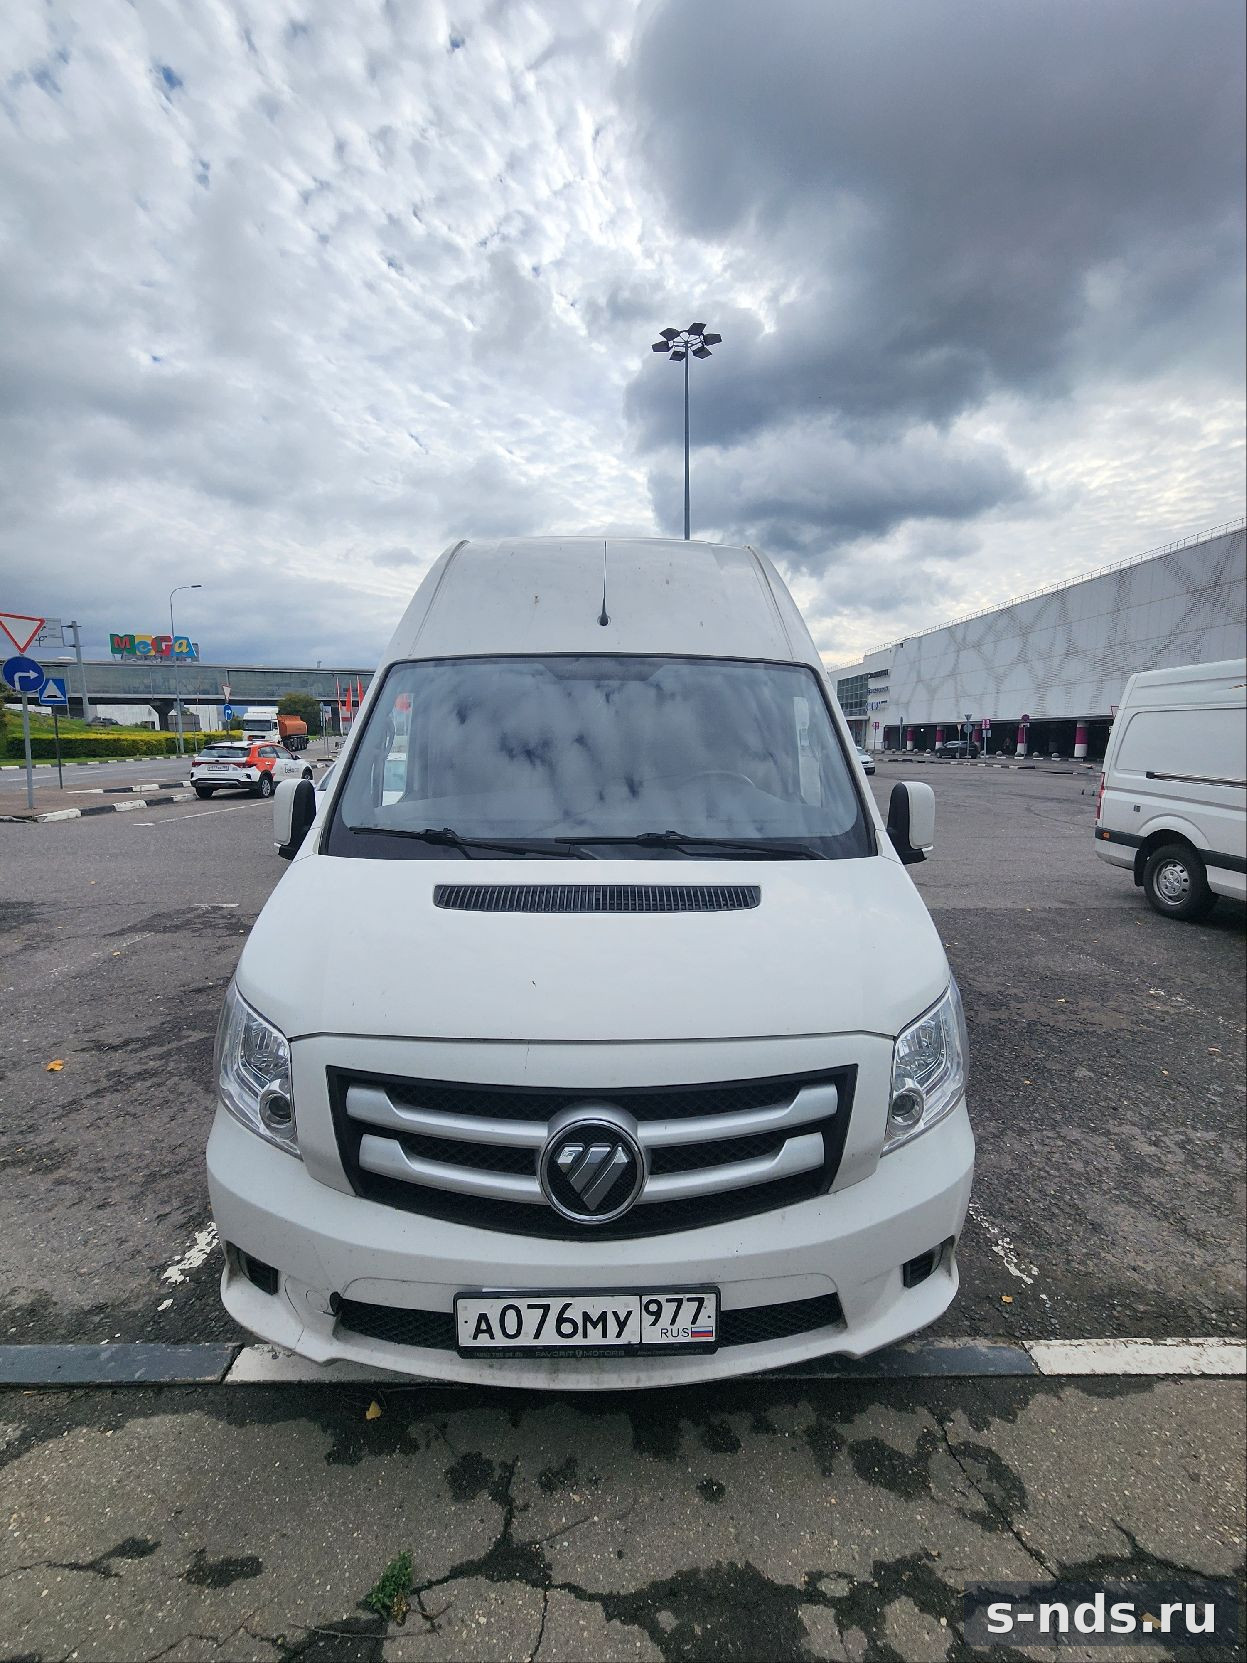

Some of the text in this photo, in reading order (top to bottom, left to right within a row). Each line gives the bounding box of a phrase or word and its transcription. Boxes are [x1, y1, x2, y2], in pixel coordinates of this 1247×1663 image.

[643, 1297, 705, 1327] 977
[660, 1328, 690, 1339] RUS
[535, 1349, 625, 1358] FAVORIT MOTORS
